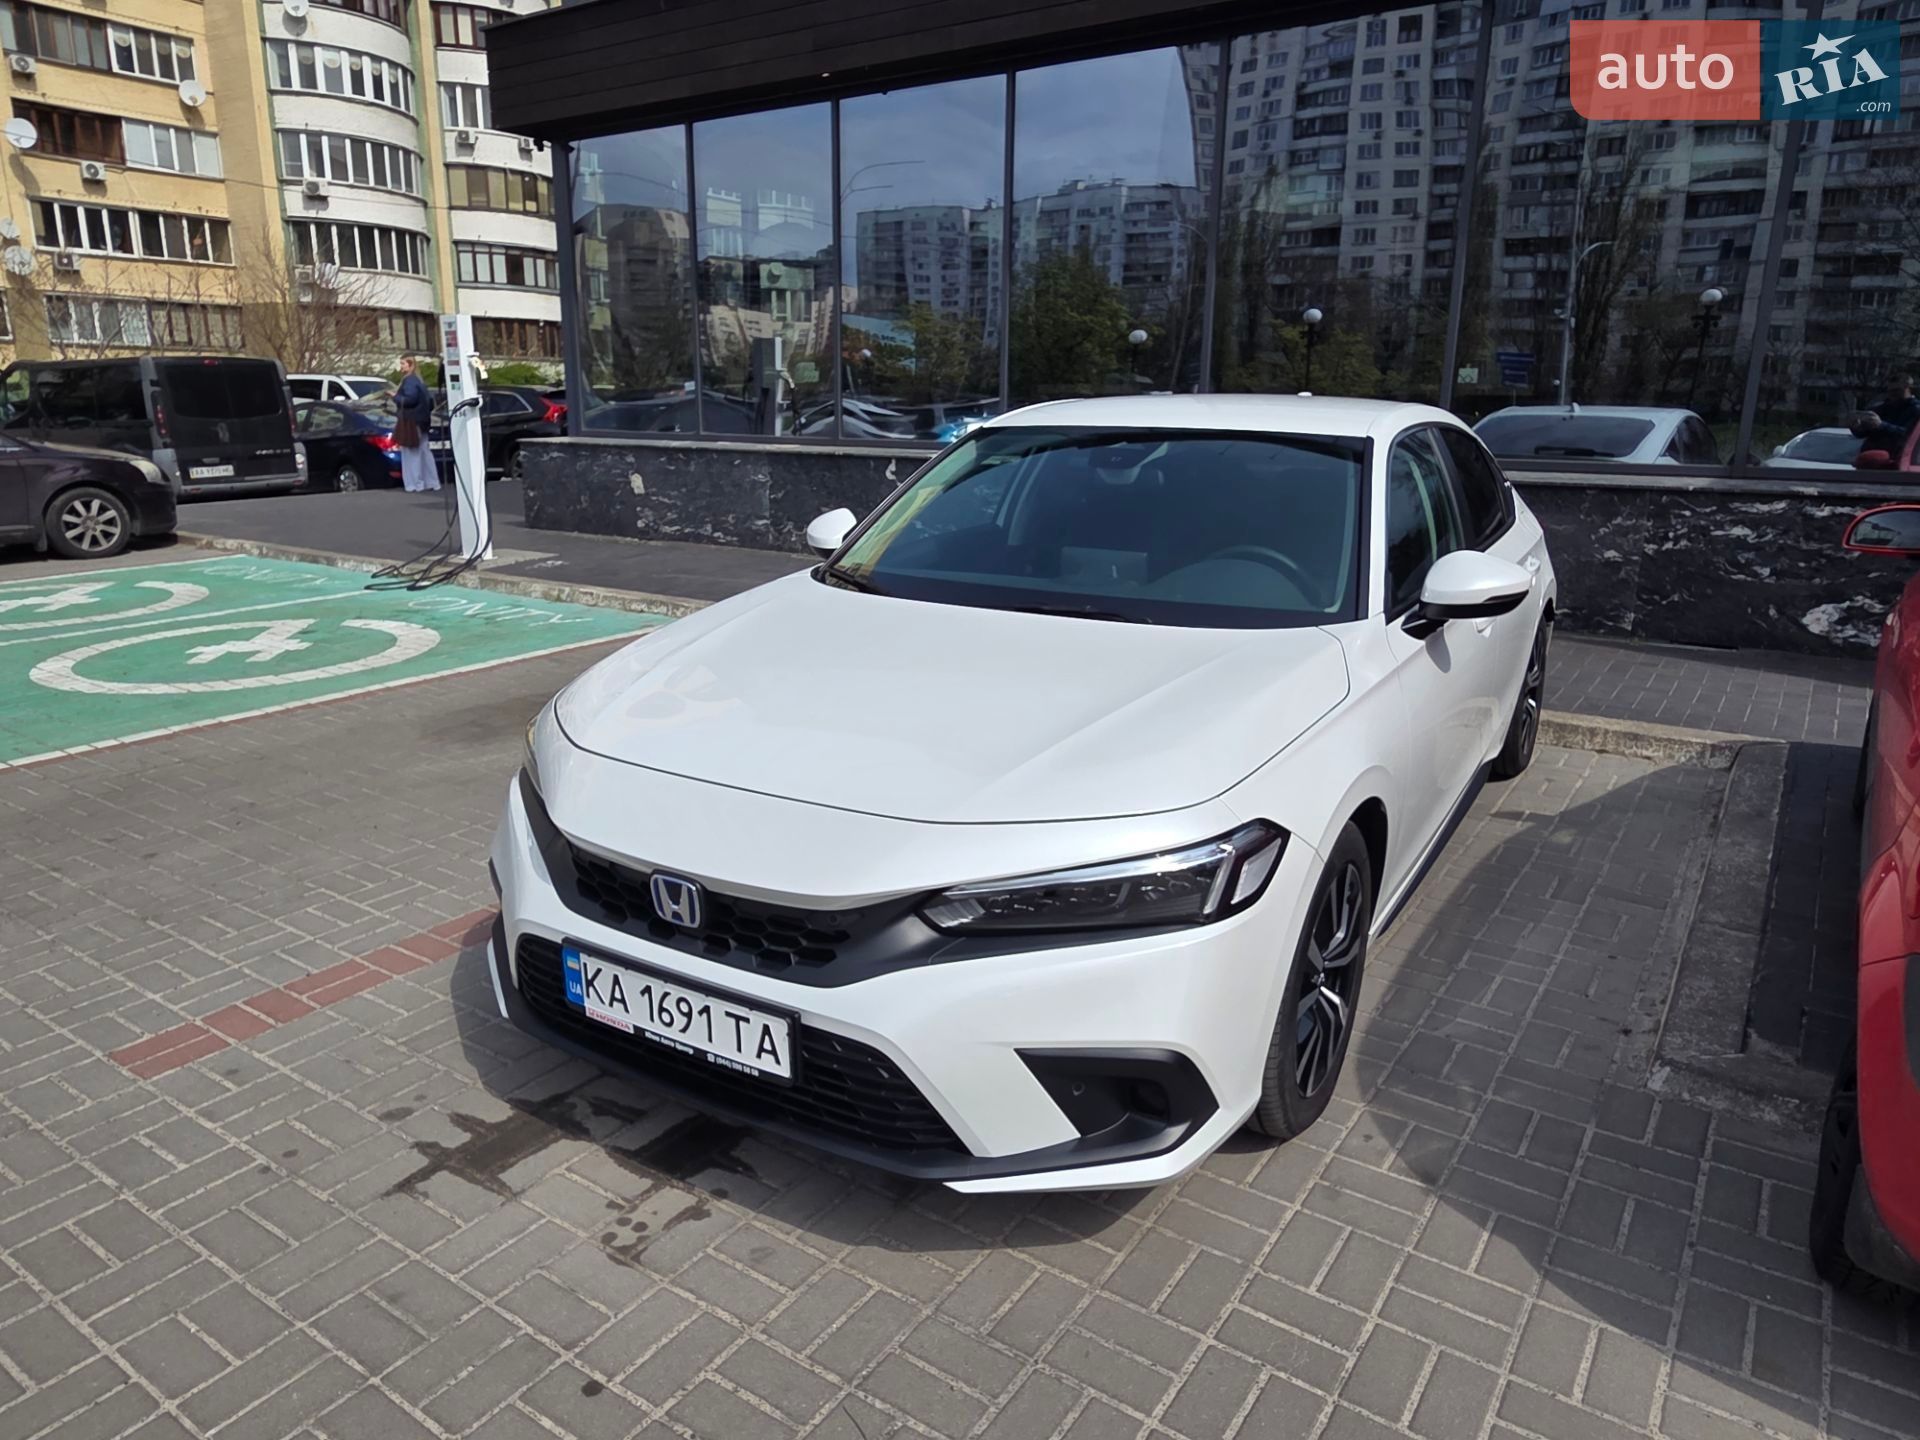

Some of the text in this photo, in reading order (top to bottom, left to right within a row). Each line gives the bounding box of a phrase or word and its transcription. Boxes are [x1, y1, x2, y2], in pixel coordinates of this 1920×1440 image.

[569, 980, 583, 996] UA
[583, 961, 630, 1015] KA
[639, 984, 713, 1044] 1691
[725, 1010, 782, 1067] TA
